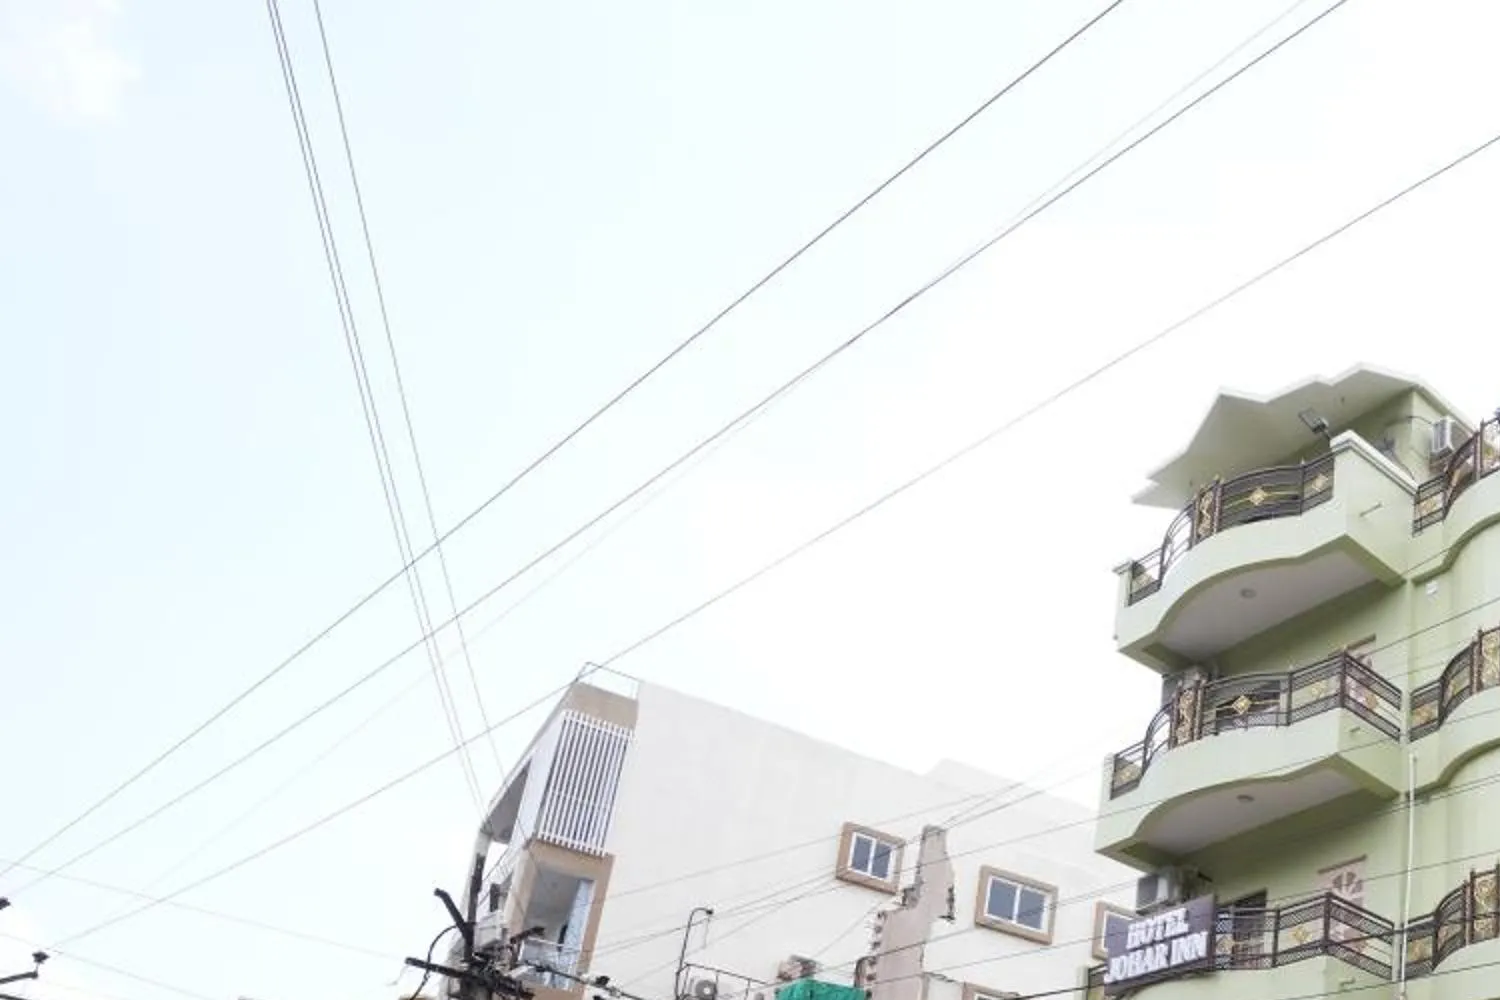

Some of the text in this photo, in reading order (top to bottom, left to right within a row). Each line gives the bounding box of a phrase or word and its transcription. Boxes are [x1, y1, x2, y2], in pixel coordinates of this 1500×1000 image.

[1126, 907, 1189, 949] HOTEL
[1103, 931, 1208, 984] JOHAR INN
